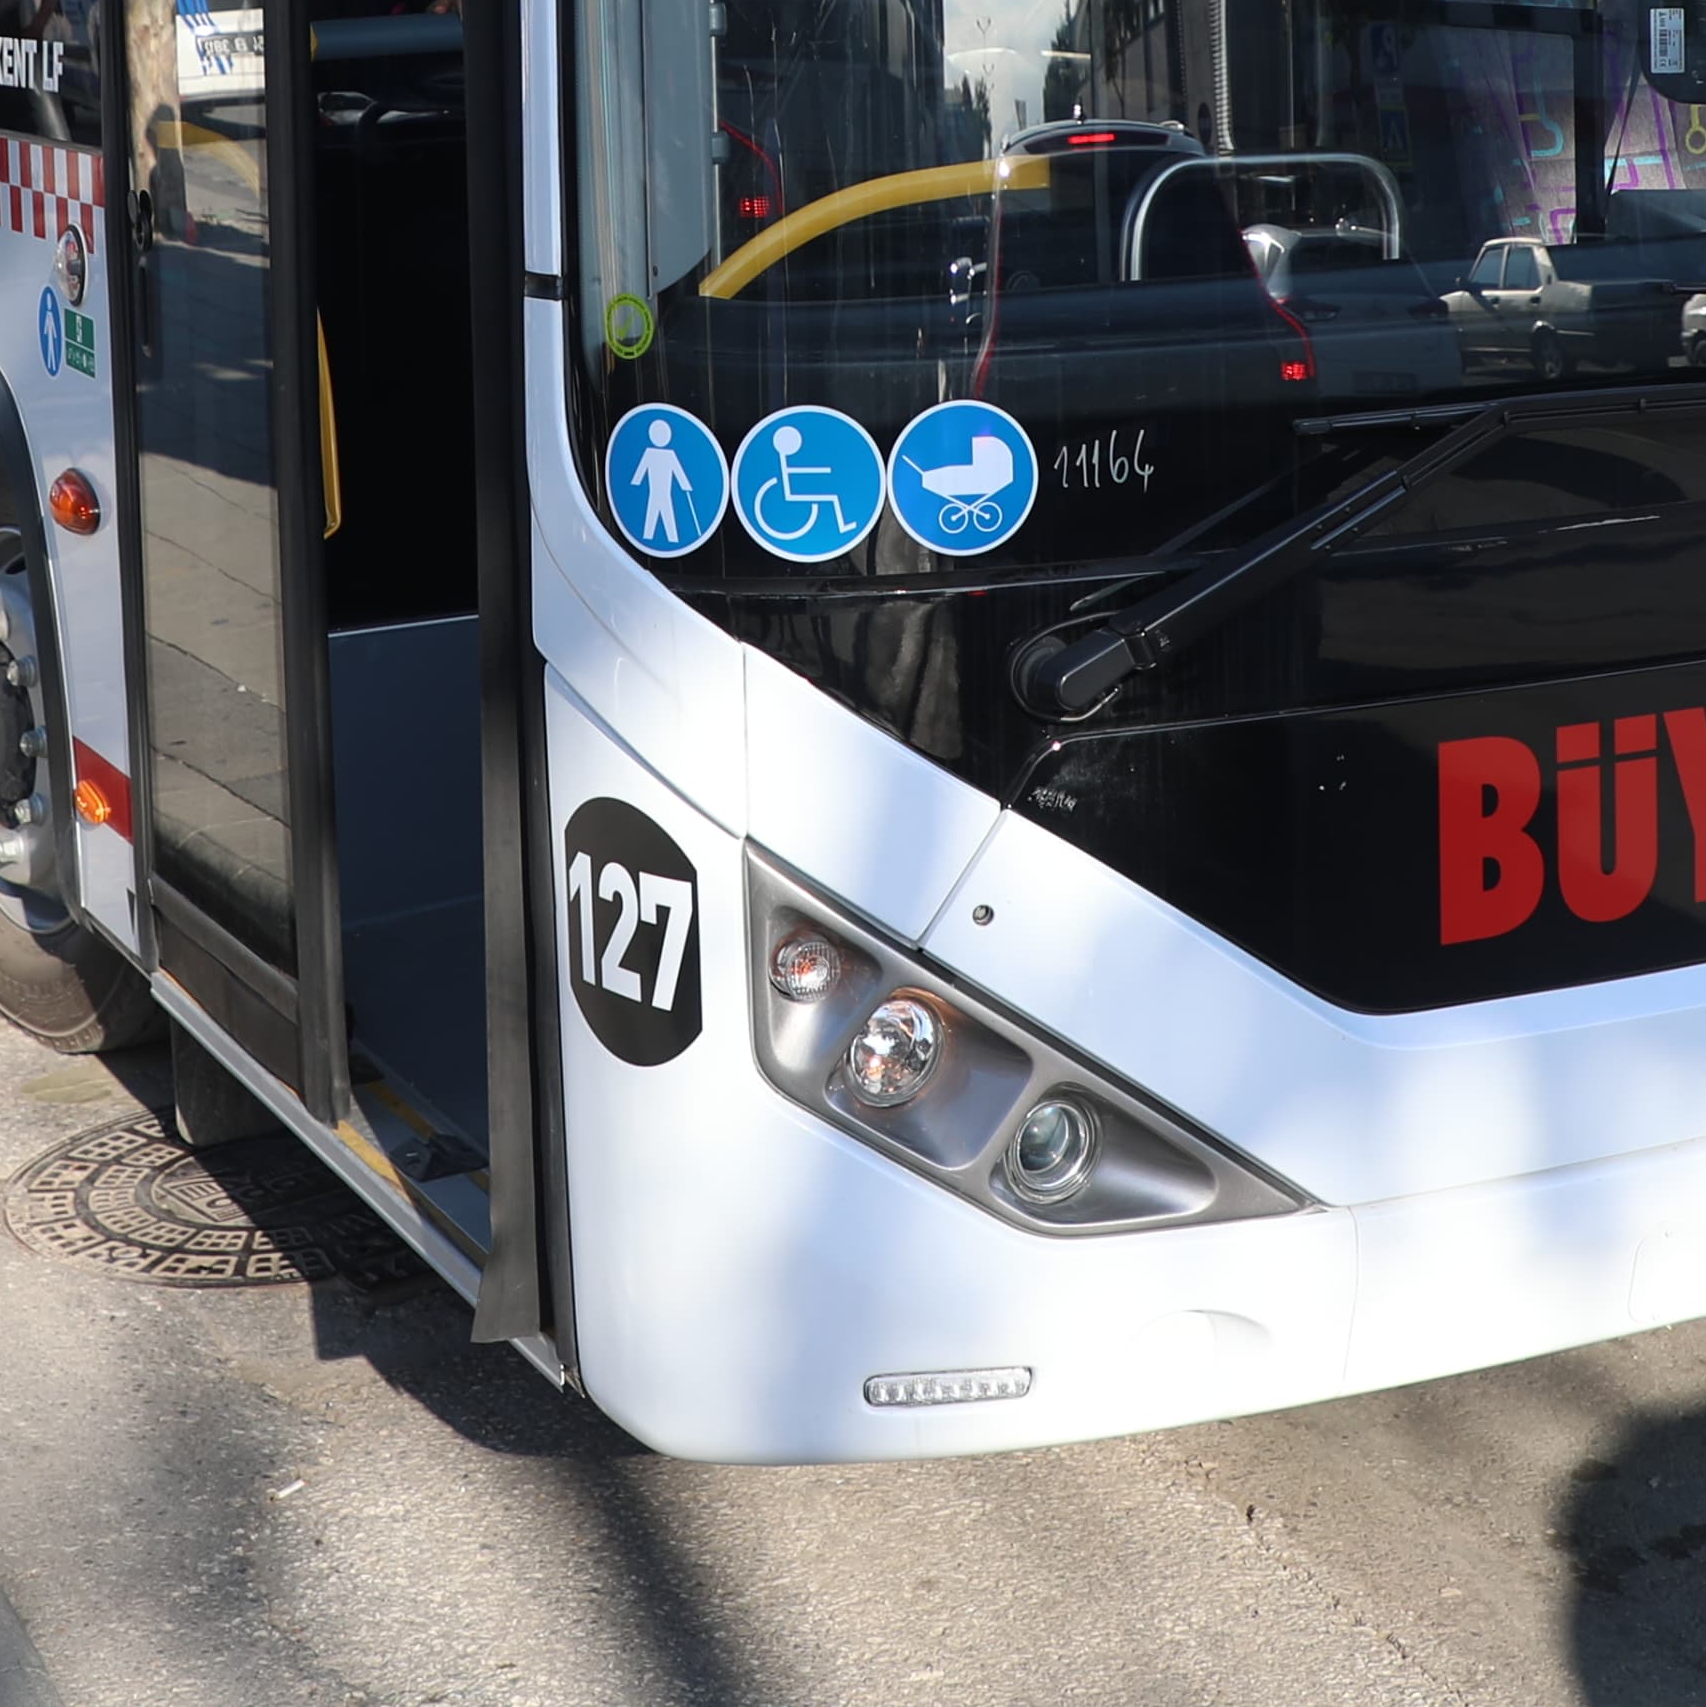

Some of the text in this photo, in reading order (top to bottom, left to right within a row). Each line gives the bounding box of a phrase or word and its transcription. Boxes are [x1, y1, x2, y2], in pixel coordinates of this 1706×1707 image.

[42, 40, 64, 93] LF
[1053, 429, 1154, 494] 11164
[569, 851, 693, 1012] 127
